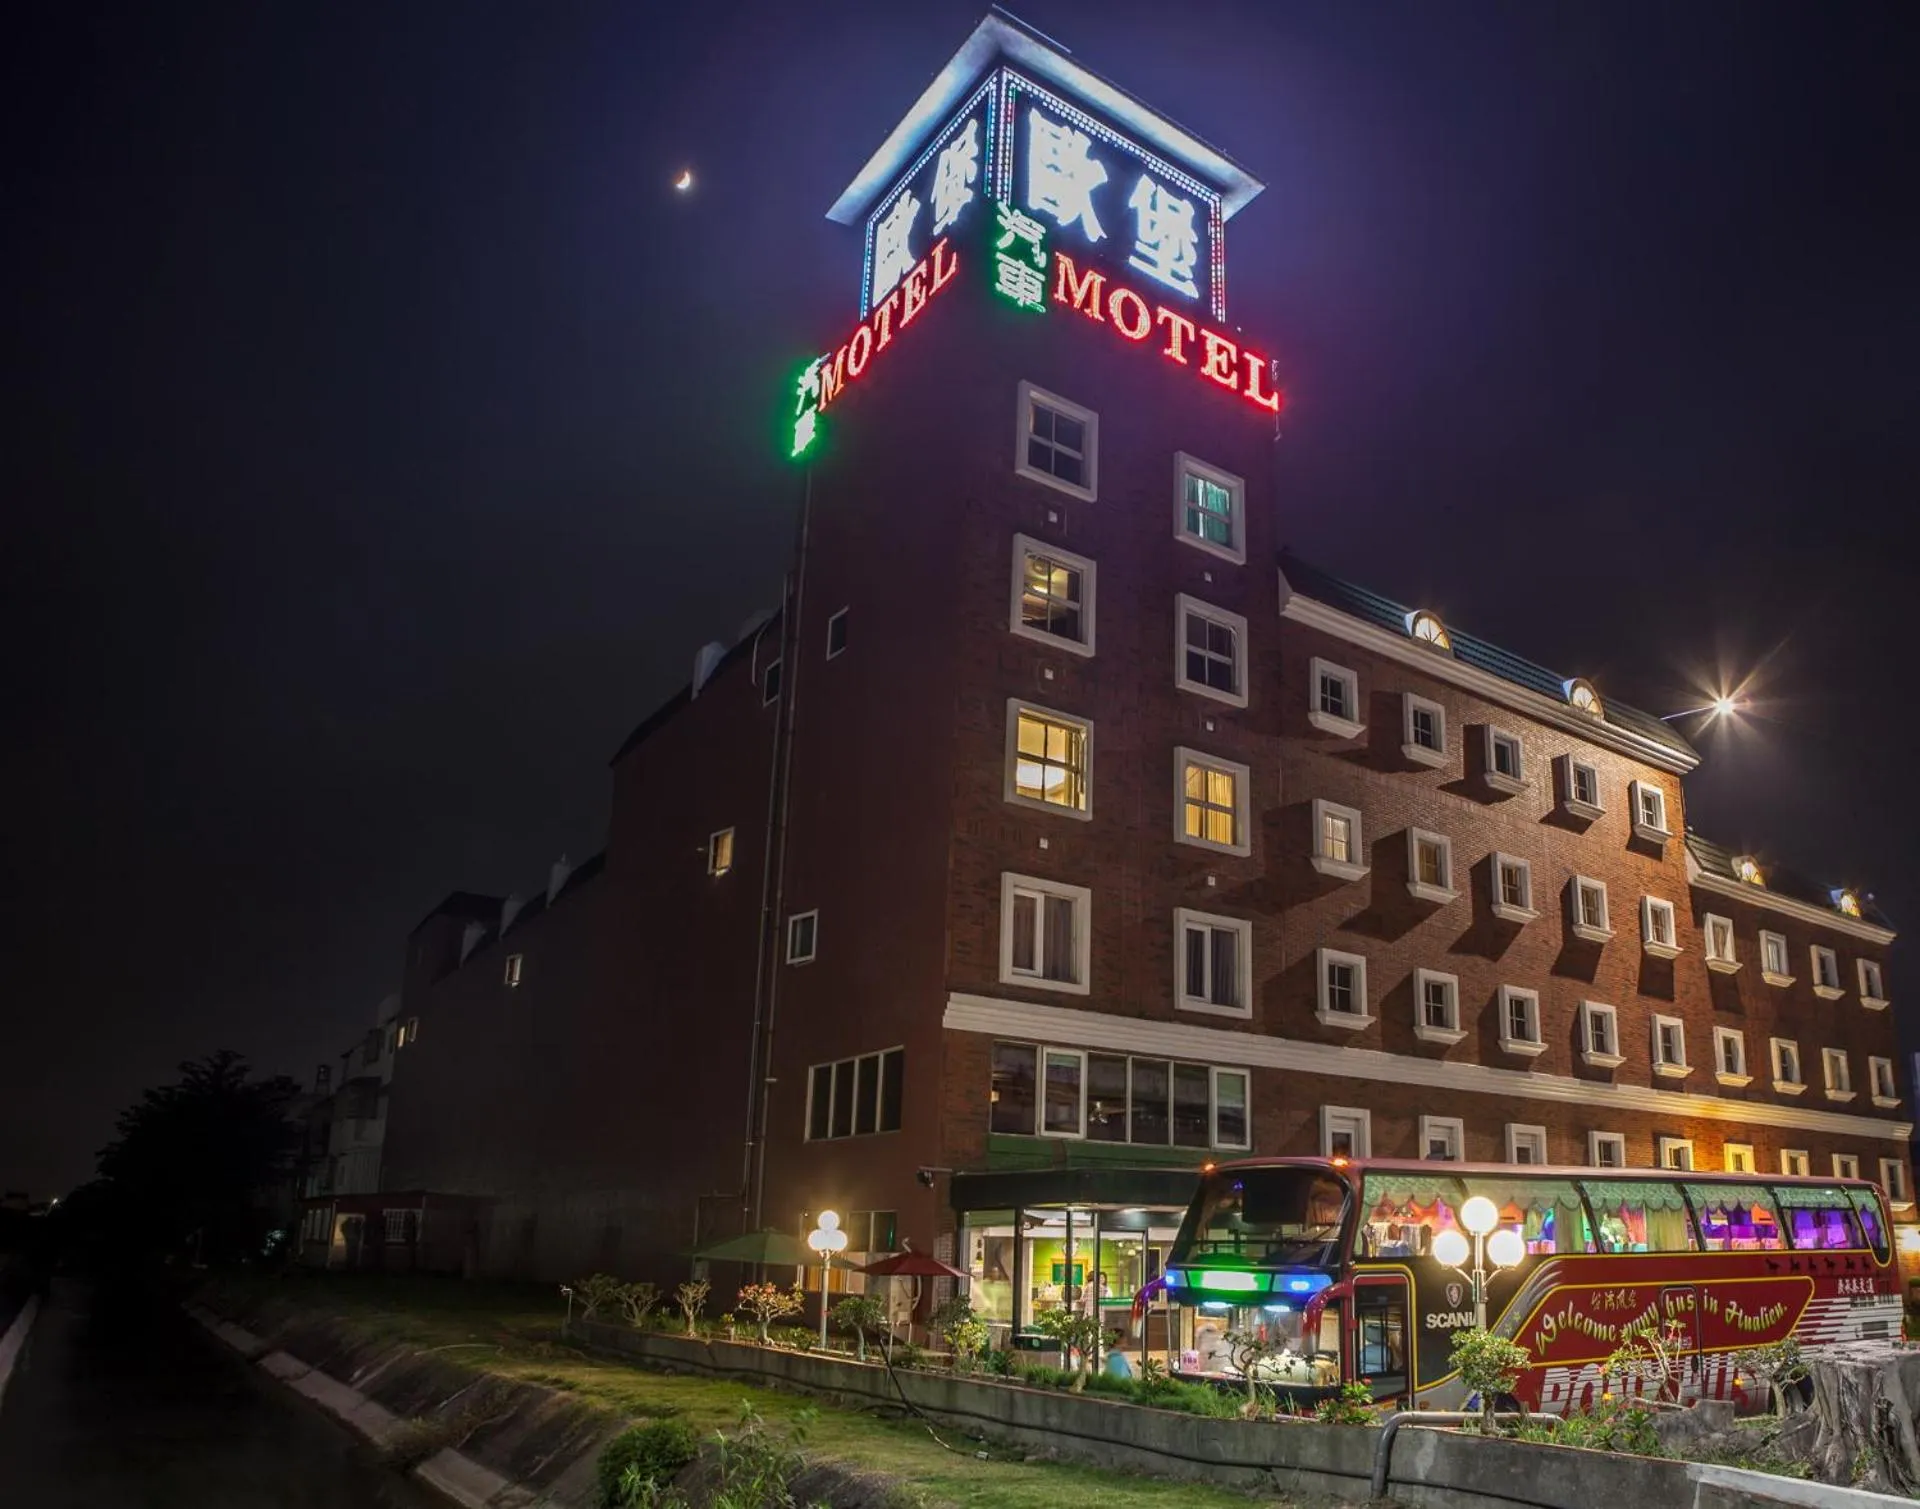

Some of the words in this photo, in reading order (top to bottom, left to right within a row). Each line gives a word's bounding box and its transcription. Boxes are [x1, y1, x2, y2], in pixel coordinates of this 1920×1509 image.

[996, 202, 1047, 313] 汽車
[1027, 106, 1199, 299] 歐堡
[817, 237, 957, 412] MOTEL
[1052, 251, 1279, 412] MOTEL
[1535, 1300, 1616, 1356] Welcome
[1665, 1294, 1695, 1319] bus
[1703, 1288, 1719, 1315] in
